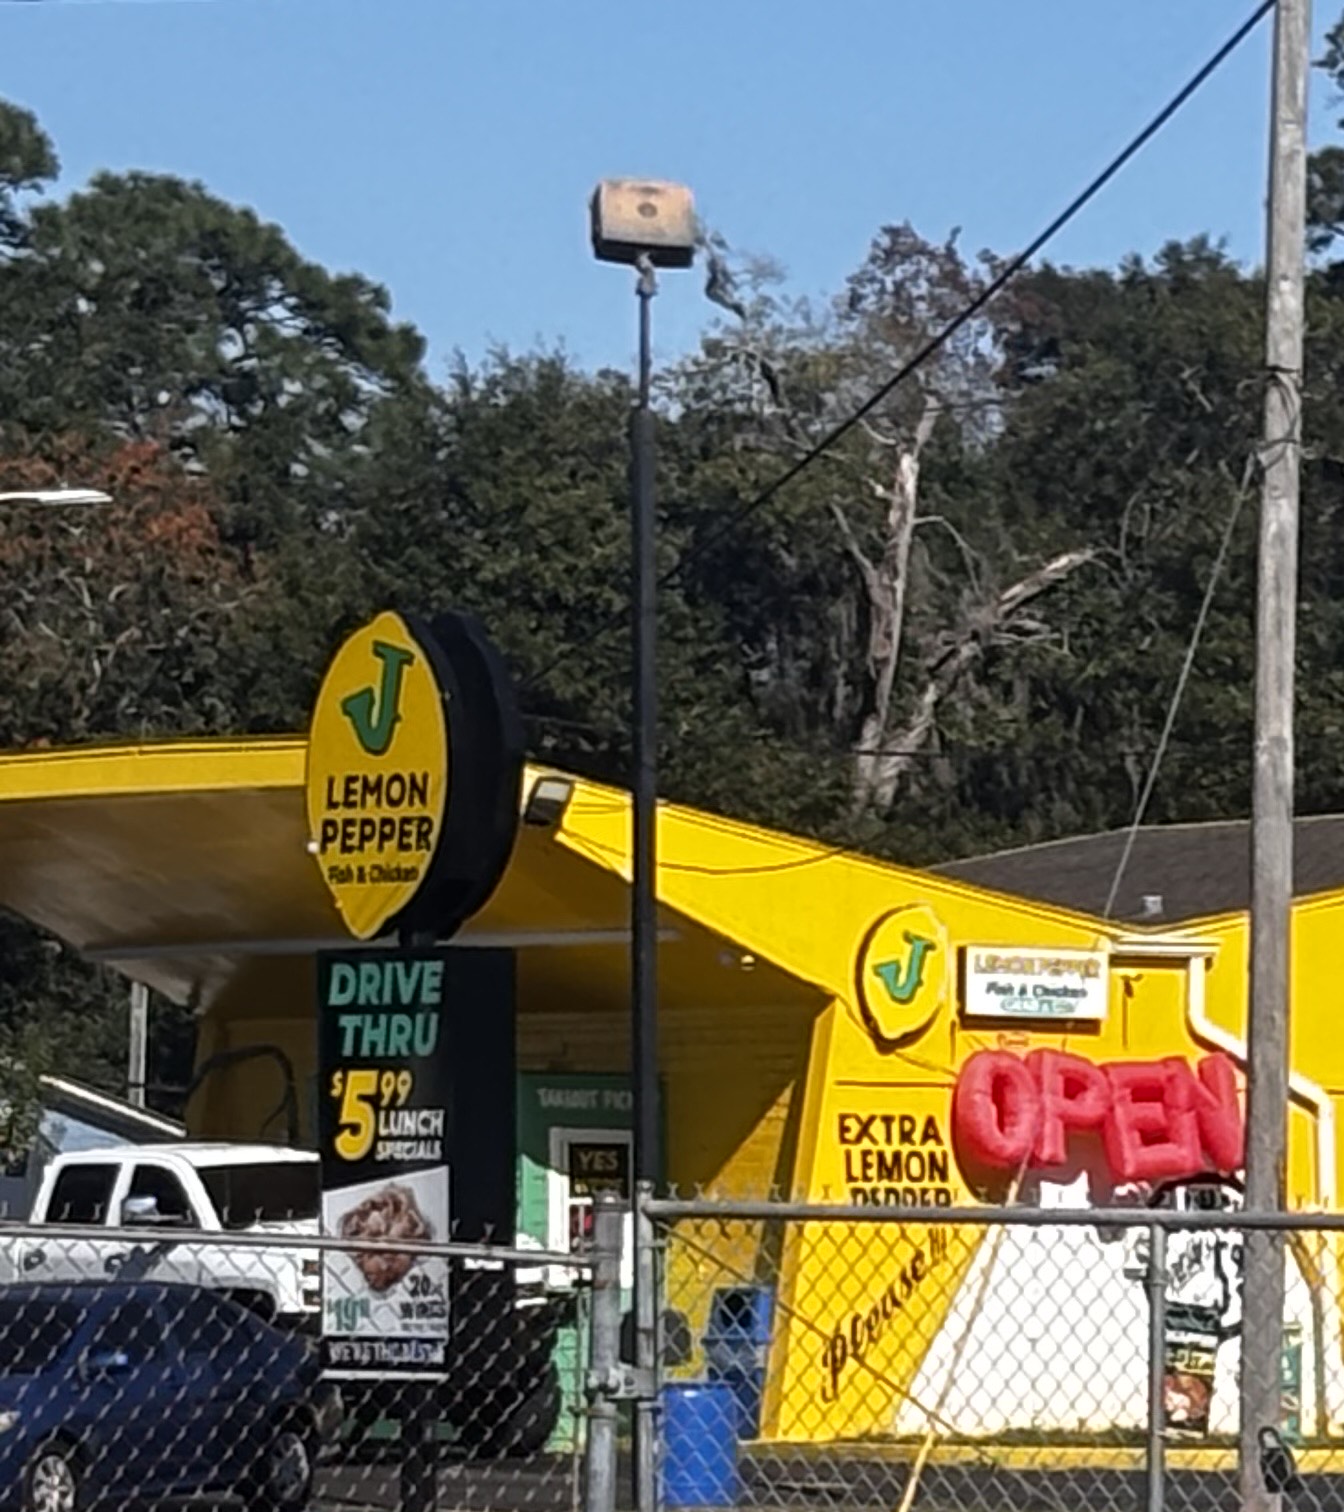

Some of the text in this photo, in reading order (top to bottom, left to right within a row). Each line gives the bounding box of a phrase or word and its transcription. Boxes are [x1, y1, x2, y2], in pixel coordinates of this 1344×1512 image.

[341, 640, 415, 756] J
[326, 772, 430, 809] LEMON
[320, 816, 434, 854] PEPPER
[328, 960, 444, 1006] DRIVE
[872, 930, 937, 1005] J
[338, 1012, 440, 1057] THRU
[378, 1109, 445, 1137] LUNCH
[838, 1113, 944, 1146] EXTRA
[952, 1048, 1244, 1180] OPEN
[844, 1149, 948, 1183] LEMON
